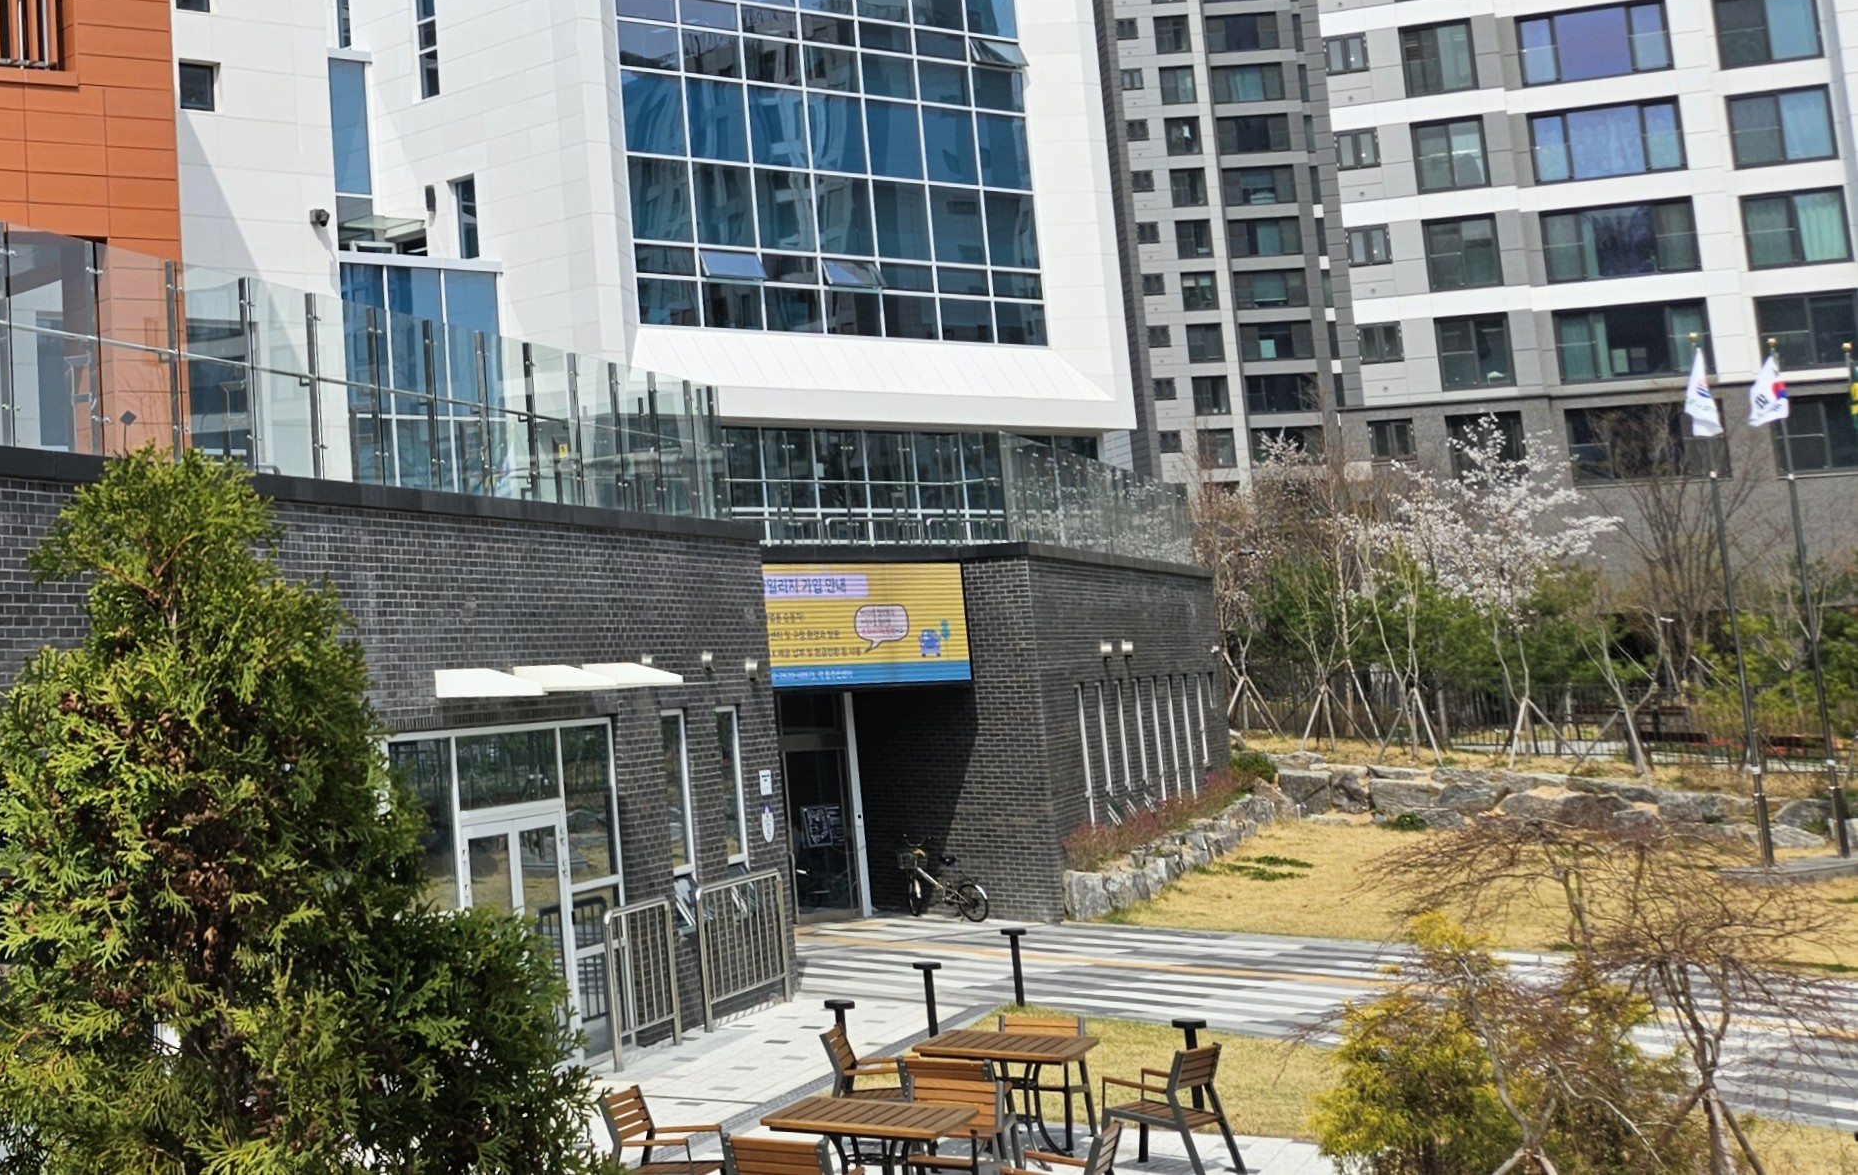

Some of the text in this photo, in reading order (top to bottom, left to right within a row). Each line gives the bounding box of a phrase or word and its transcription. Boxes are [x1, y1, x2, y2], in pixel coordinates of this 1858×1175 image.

[765, 577, 847, 594] 일리지 가입 안내
